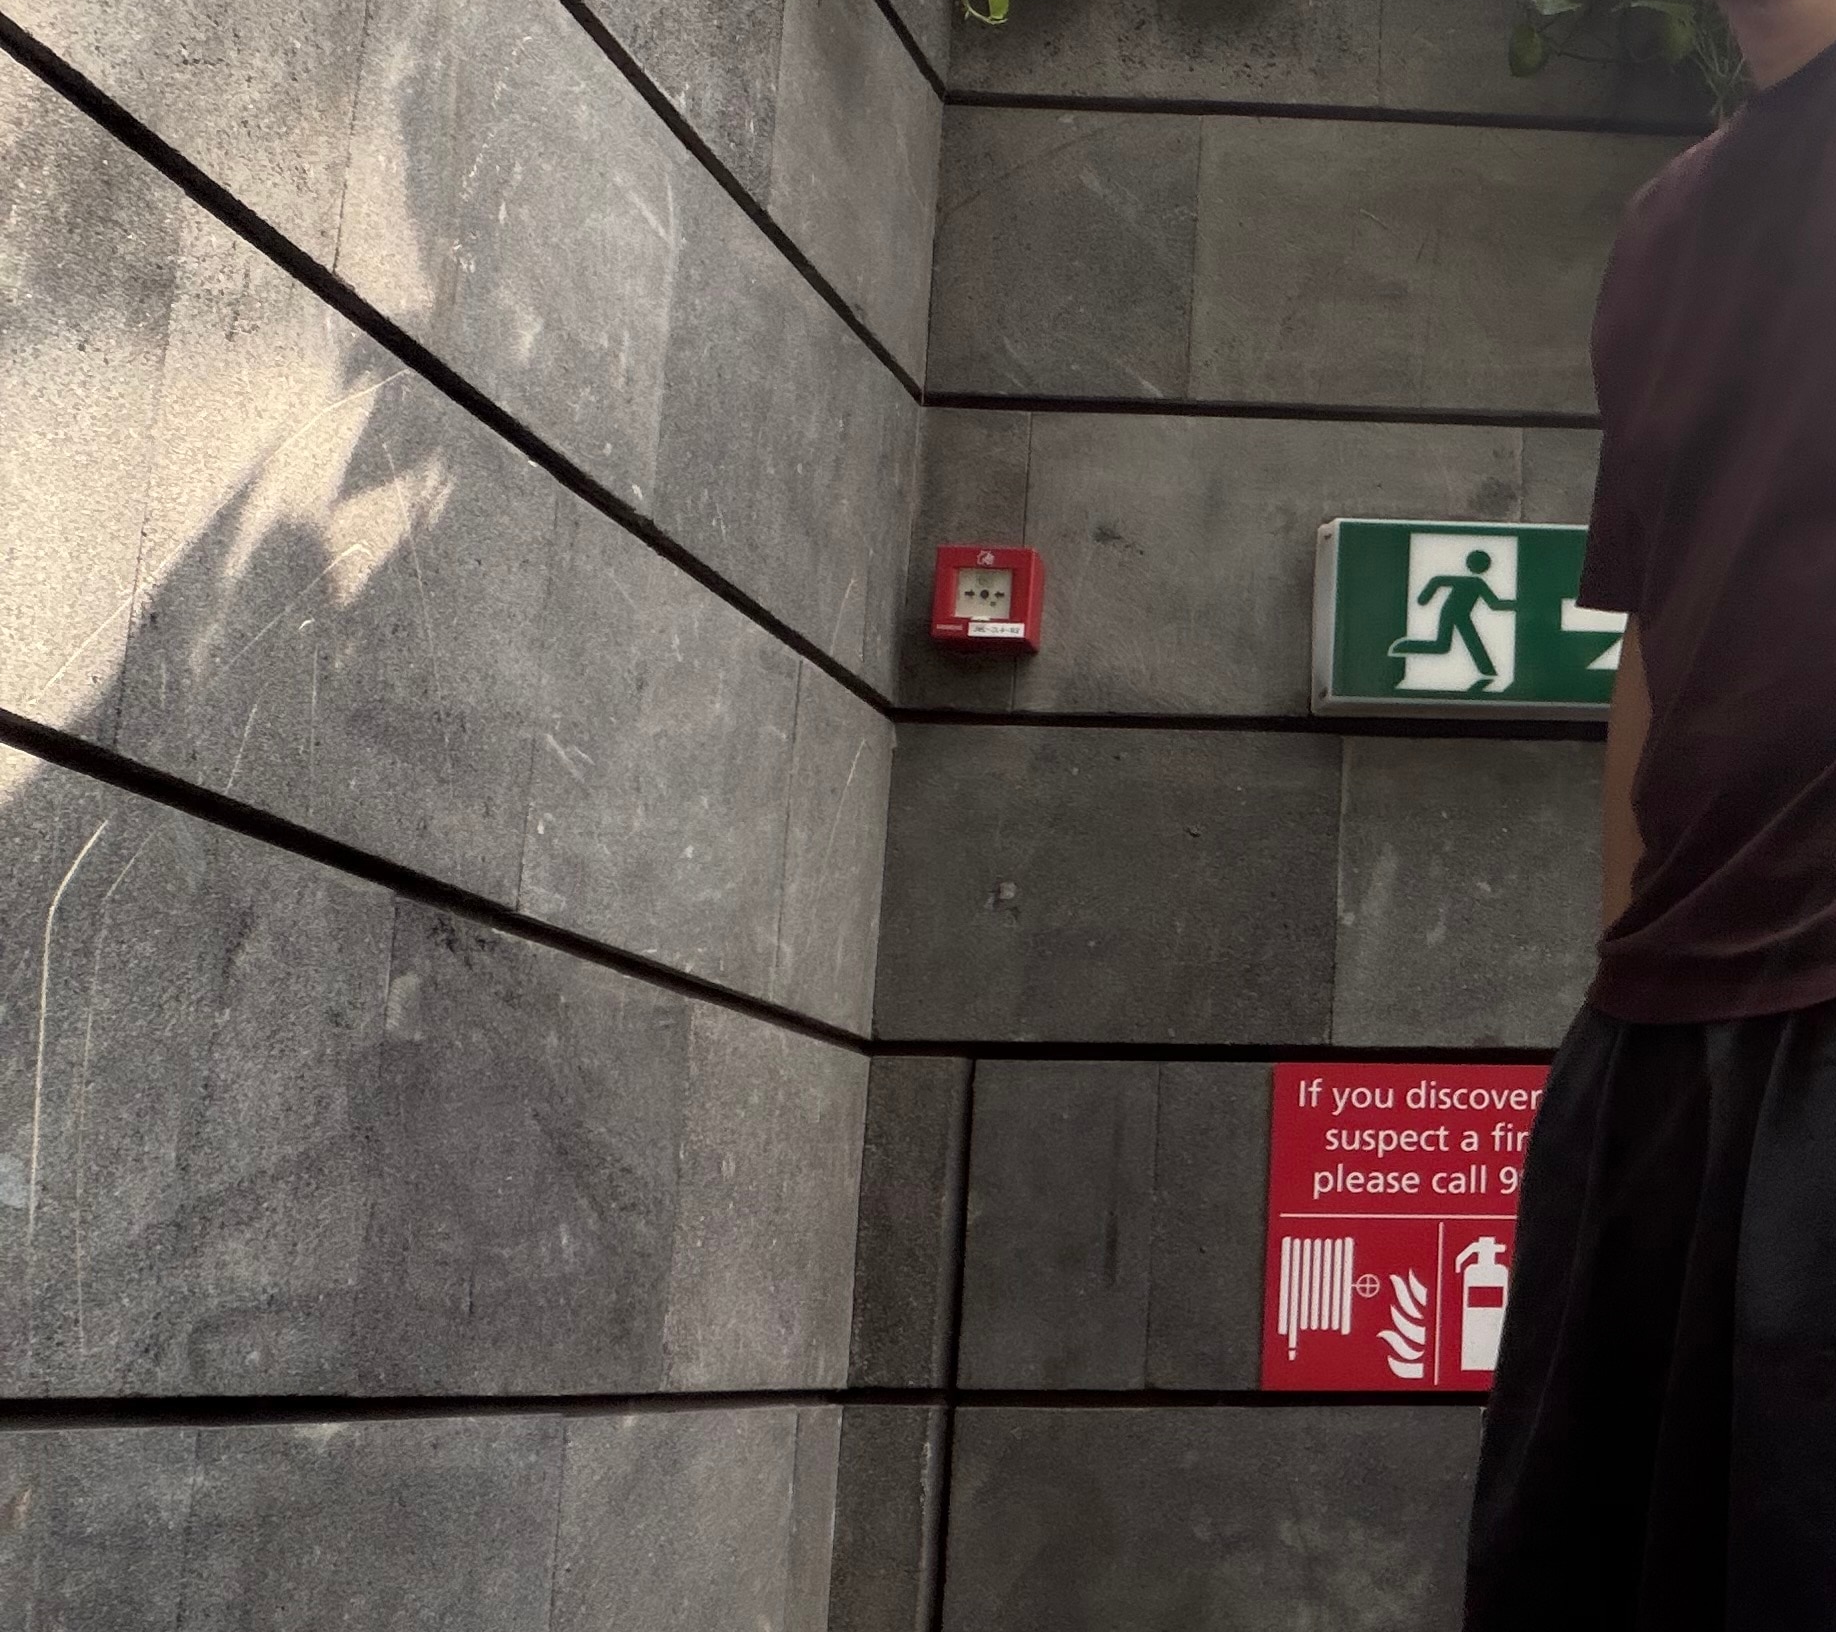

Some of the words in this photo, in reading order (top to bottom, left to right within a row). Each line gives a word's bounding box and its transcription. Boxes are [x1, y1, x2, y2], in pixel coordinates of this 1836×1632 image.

[1299, 1078, 1323, 1107] If
[1332, 1087, 1394, 1115] you
[1406, 1081, 1543, 1110] discover
[1325, 1125, 1450, 1158] suspect
[1460, 1131, 1480, 1152] a
[1491, 1122, 1529, 1152] fir
[1313, 1163, 1421, 1200] please
[1431, 1164, 1487, 1194] call
